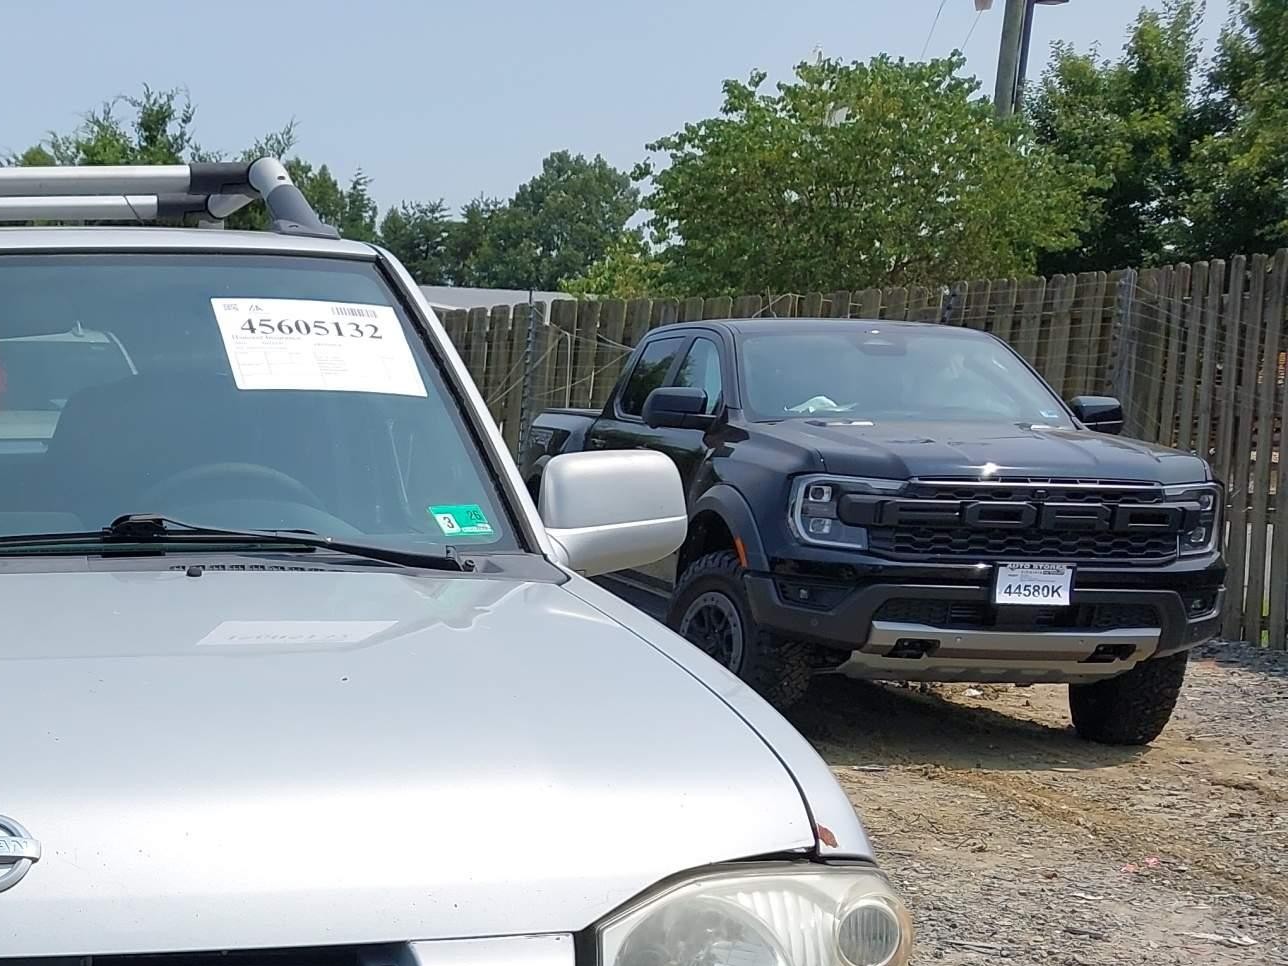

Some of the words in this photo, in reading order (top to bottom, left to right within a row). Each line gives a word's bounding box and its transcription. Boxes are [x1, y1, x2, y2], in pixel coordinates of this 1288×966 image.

[241, 317, 383, 340] 45605132
[443, 516, 455, 529] 3
[882, 499, 1181, 531] FORD
[1004, 583, 1063, 598] 44580K
